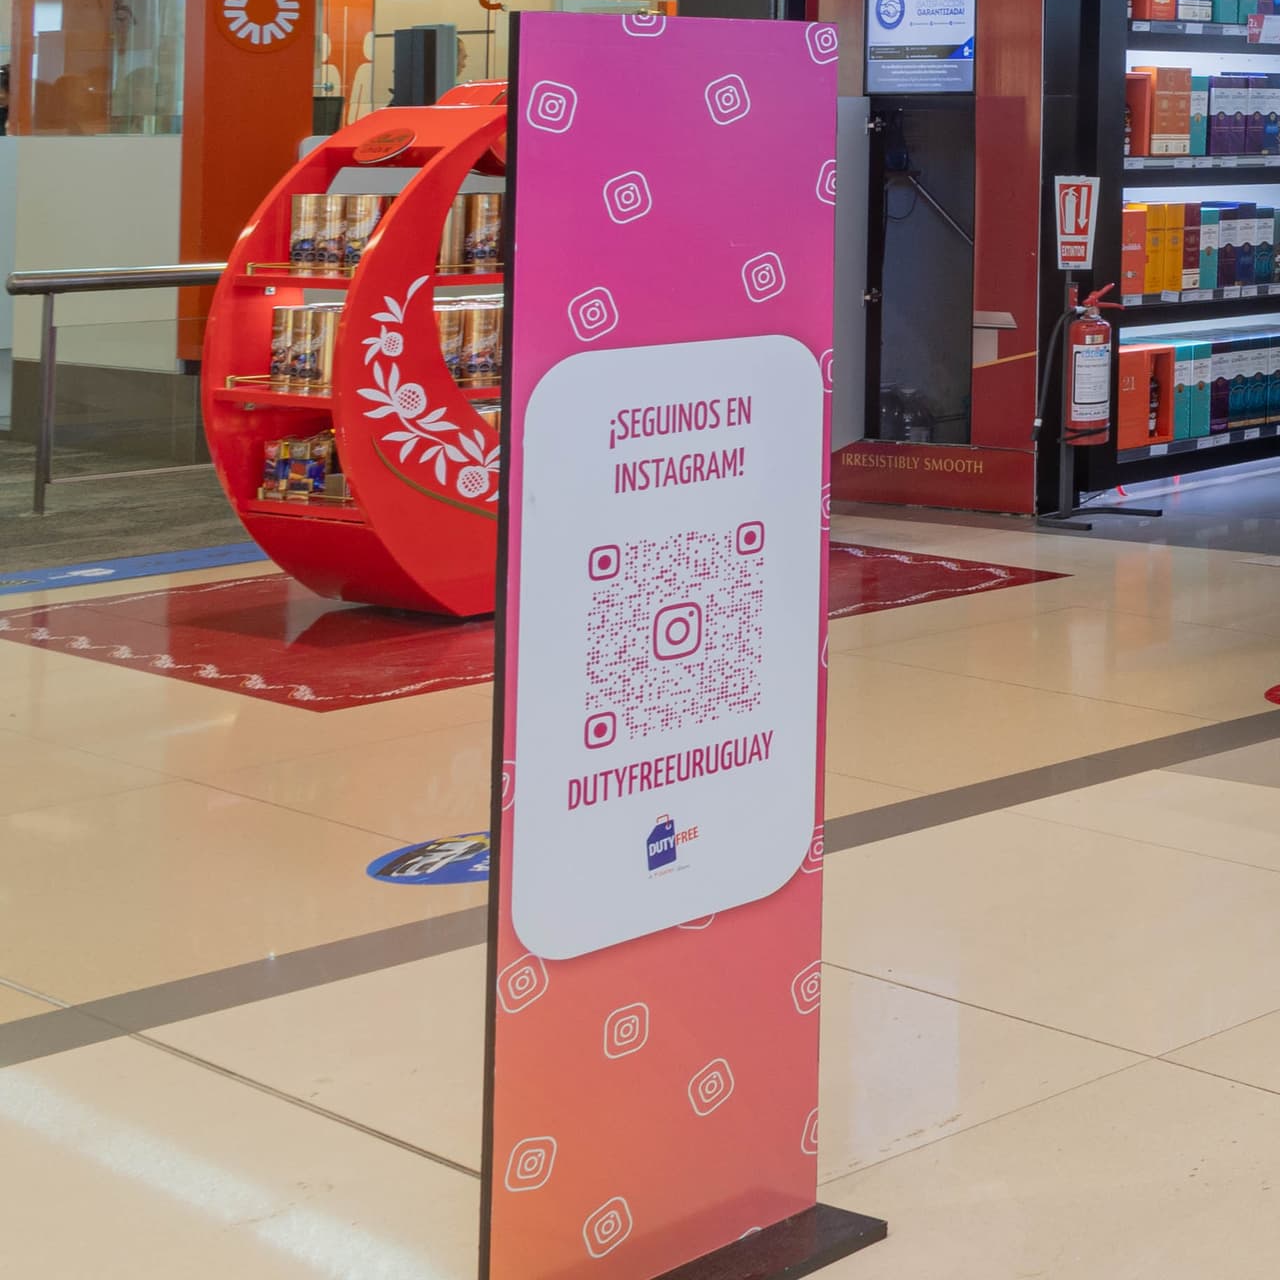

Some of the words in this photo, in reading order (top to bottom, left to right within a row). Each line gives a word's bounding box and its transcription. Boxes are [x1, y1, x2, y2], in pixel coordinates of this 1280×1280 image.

[609, 400, 721, 449] ¡SEGUINOS
[727, 395, 752, 426] EN
[614, 447, 745, 493] INSTAGRAM!
[842, 452, 920, 470] IRRESISTIBLY
[924, 457, 984, 474] SMOOTH
[568, 730, 773, 810] DUTYFREEURUGUAY
[649, 835, 675, 857] DUTY
[675, 825, 699, 846] FREE
